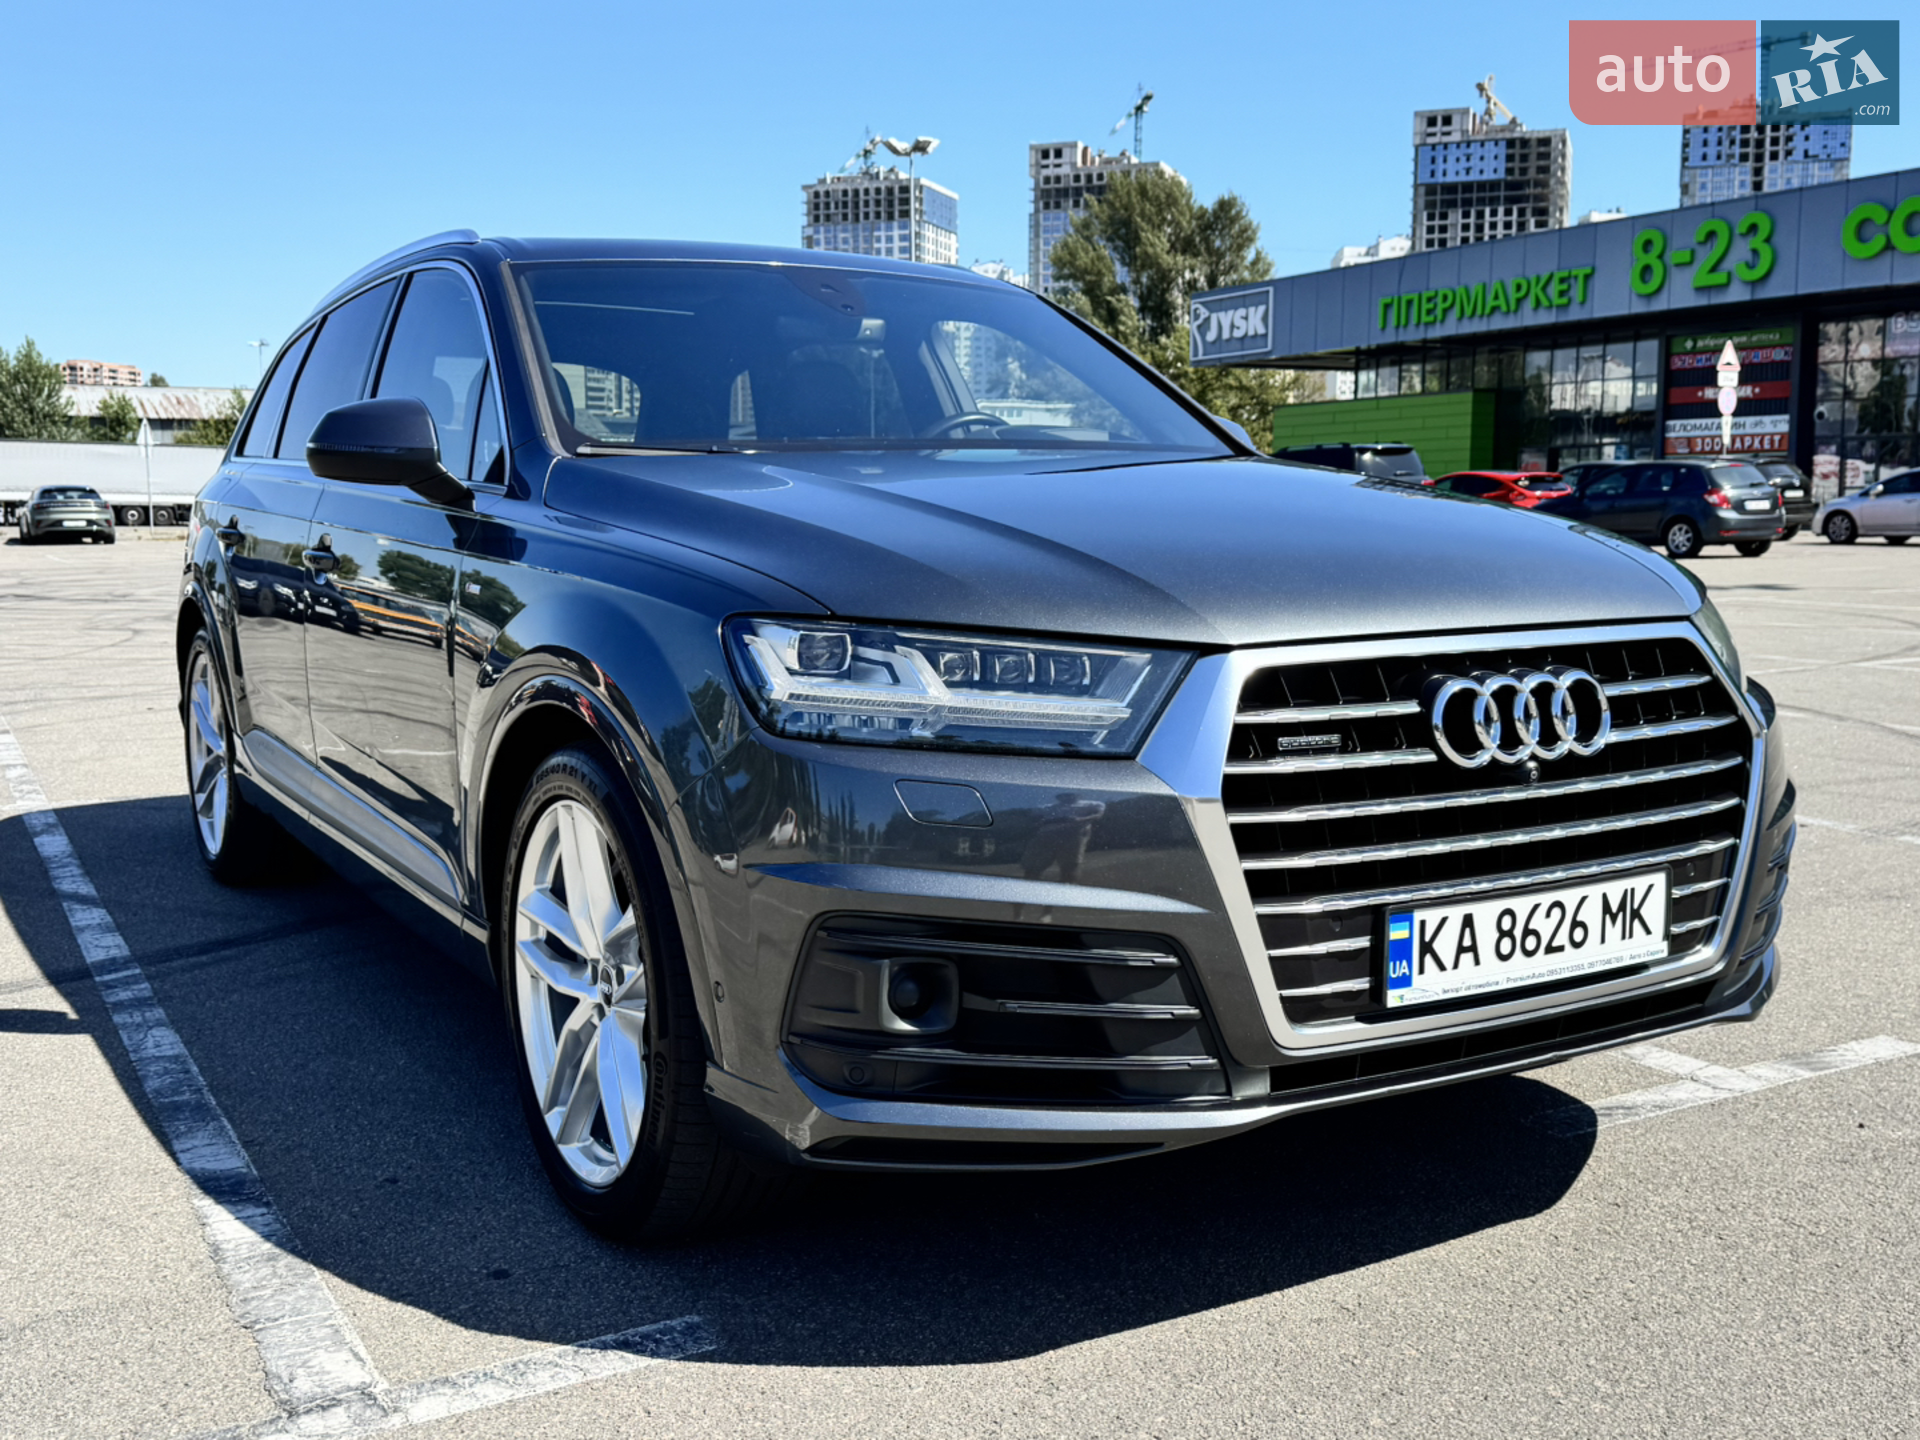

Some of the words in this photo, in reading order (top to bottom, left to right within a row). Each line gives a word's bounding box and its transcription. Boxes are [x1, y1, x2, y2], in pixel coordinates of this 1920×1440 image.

[1378, 266, 1595, 330] ГІПЕРМАРКЕТ
[1630, 210, 1775, 296] 8-23
[1205, 304, 1267, 342] JYSK
[1666, 420, 1746, 433] ВЕЛОМАГАИН
[1418, 913, 1481, 976] KA
[1494, 895, 1589, 962] 8626
[1599, 883, 1655, 945] MK
[1390, 959, 1410, 978] UA
